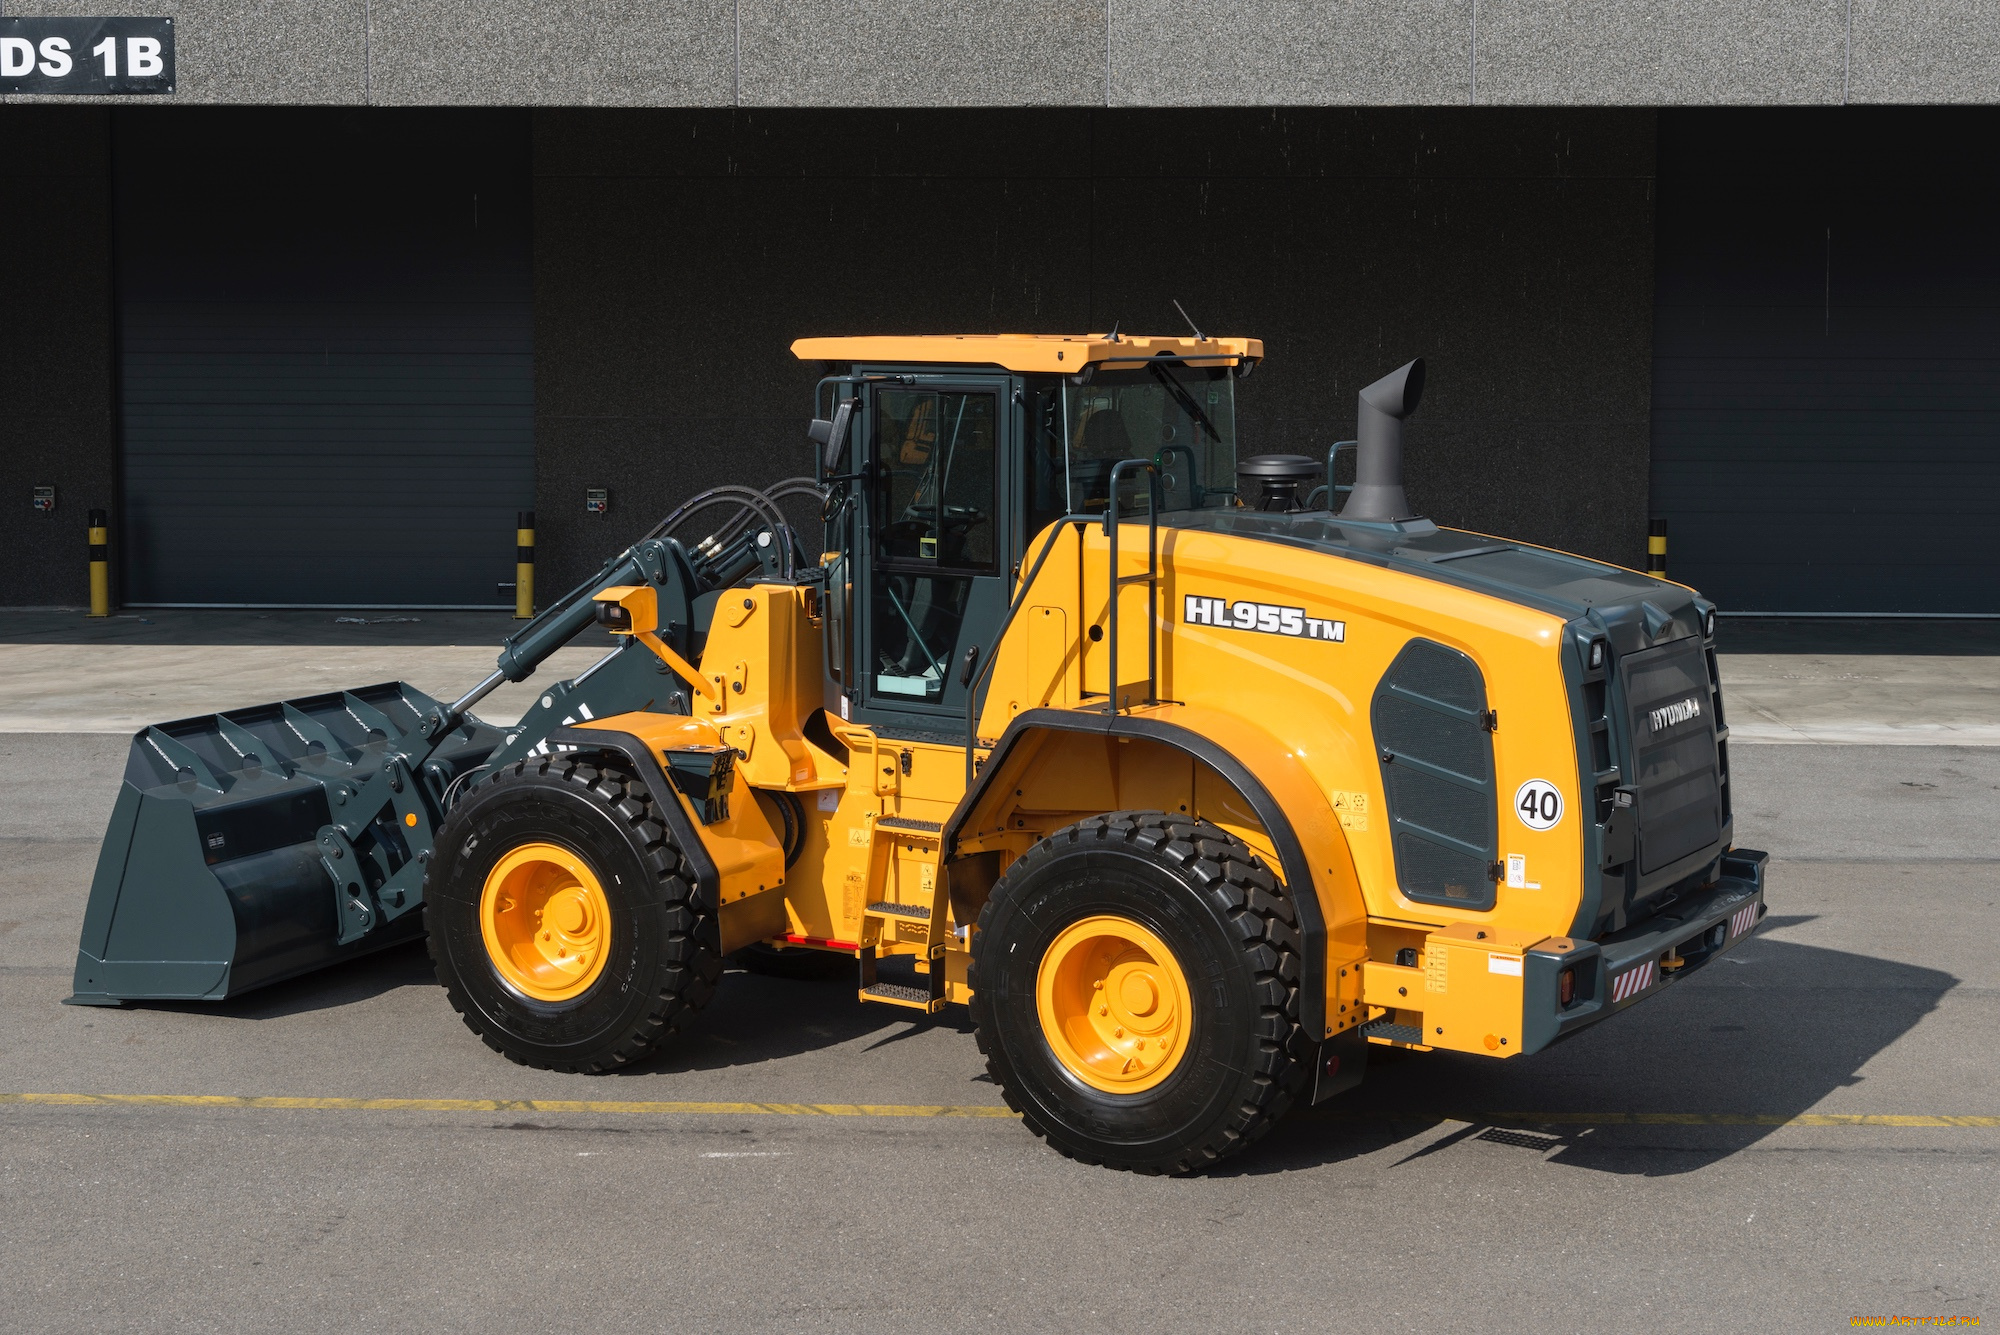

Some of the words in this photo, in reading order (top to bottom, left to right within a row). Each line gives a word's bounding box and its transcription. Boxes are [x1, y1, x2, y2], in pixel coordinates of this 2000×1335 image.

[0, 36, 73, 78] DS
[93, 36, 164, 77] 1B
[1520, 788, 1558, 822] 40
